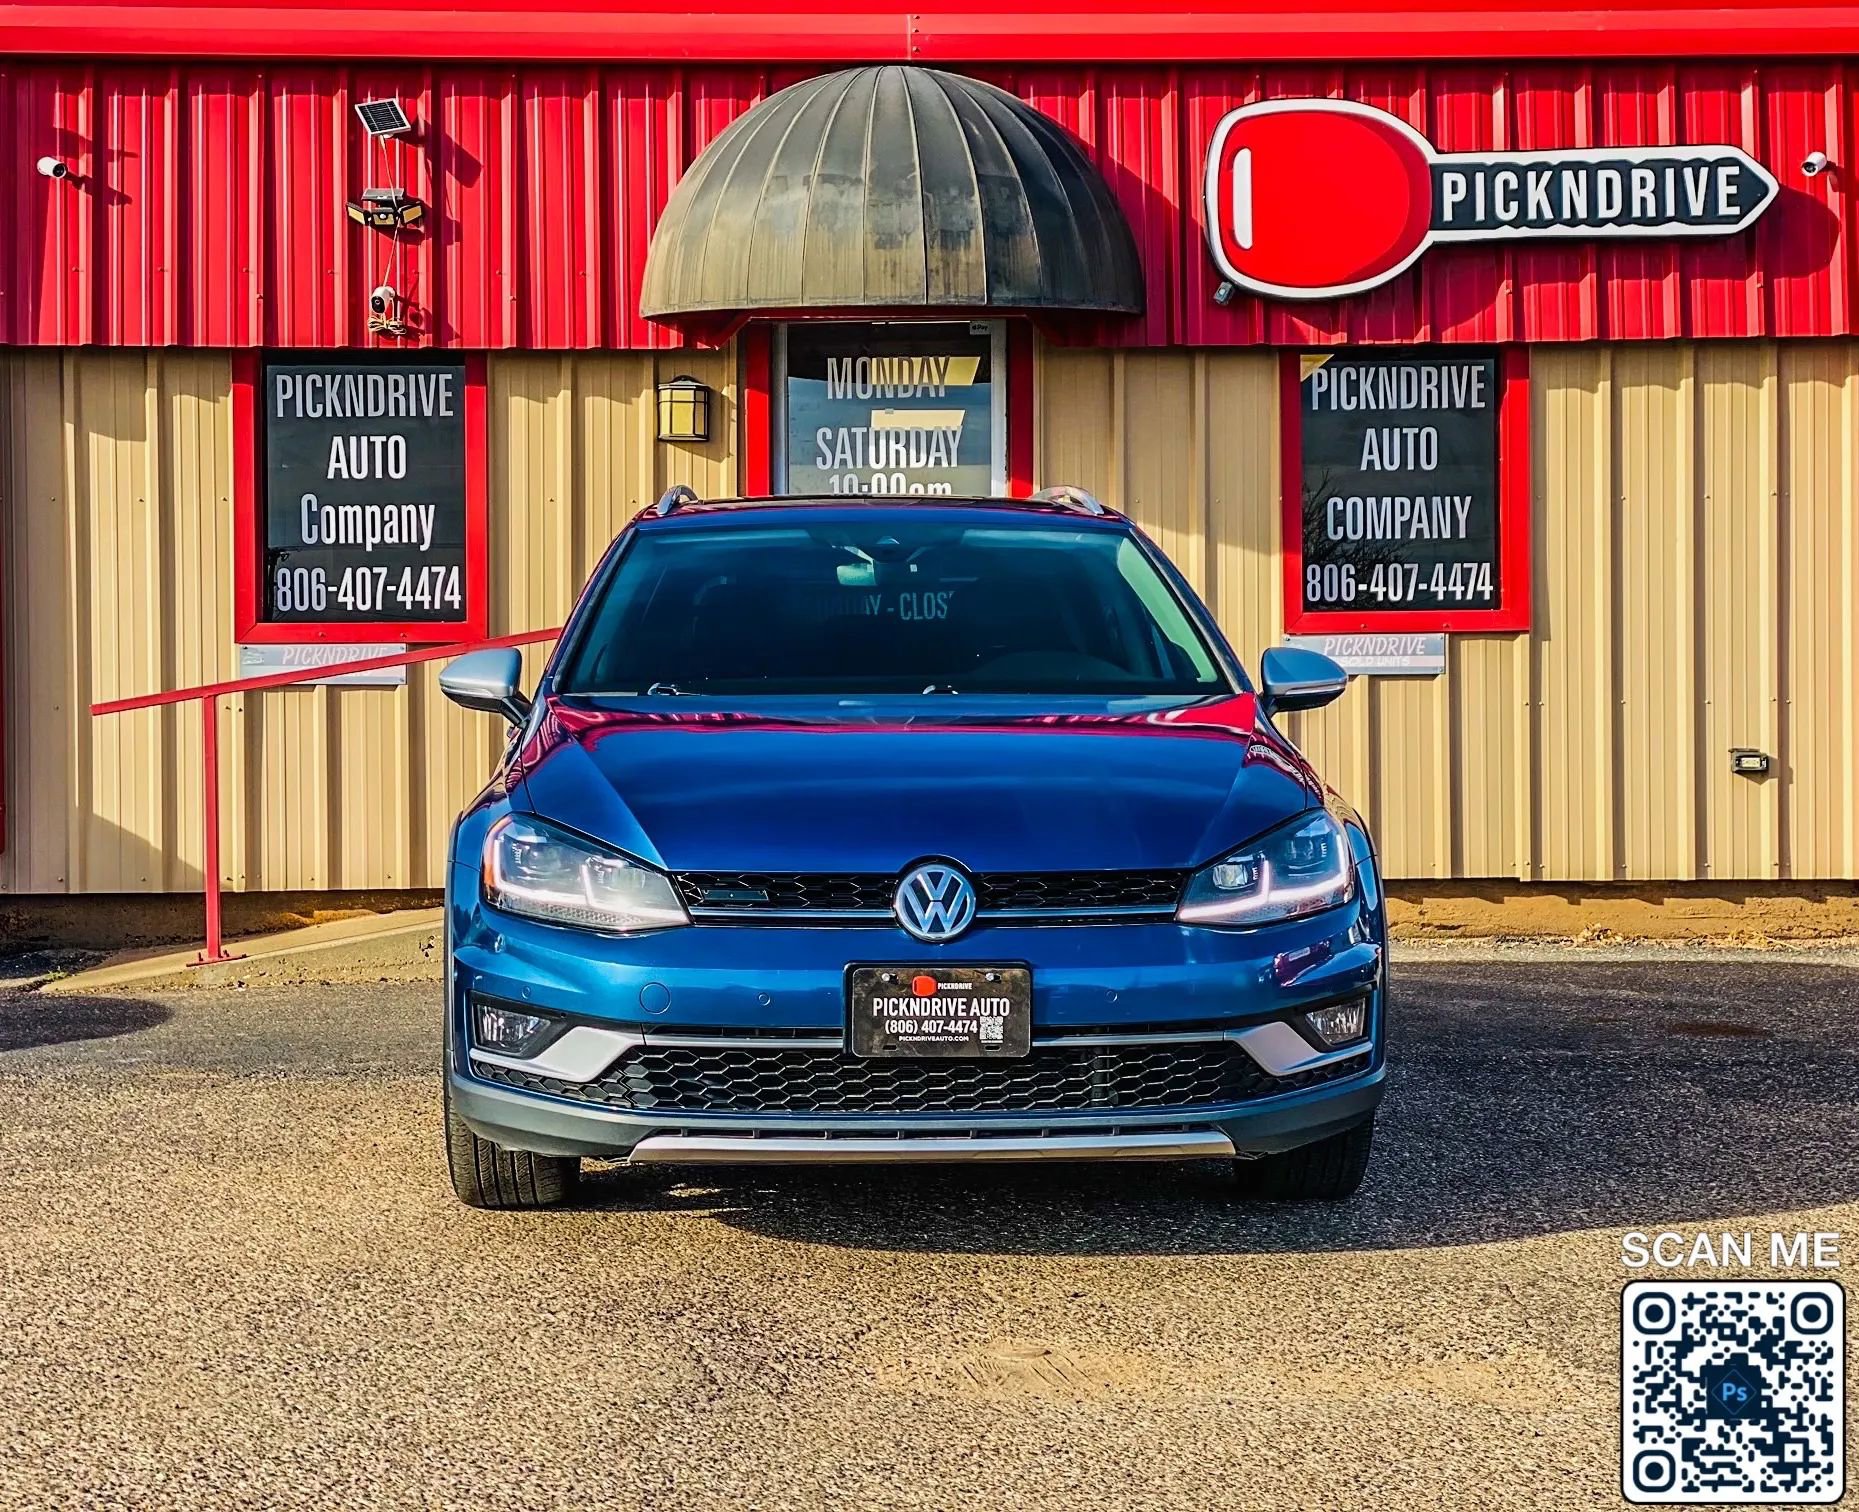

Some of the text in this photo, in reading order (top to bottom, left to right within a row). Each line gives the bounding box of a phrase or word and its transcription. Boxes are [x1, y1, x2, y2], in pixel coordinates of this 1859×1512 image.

[1443, 165, 1741, 222] PICKNDRIVE
[276, 373, 454, 418] PICKNDRIVE
[827, 355, 951, 400] MONDAY
[1312, 365, 1486, 411] PICKNDRIVE
[327, 434, 406, 480] AUTO
[816, 425, 963, 470] SATURDAY
[1360, 426, 1438, 472] AUTO
[301, 493, 436, 552] Company
[1327, 496, 1473, 541] COMPANY
[277, 565, 462, 612] 806-407-4474
[1306, 562, 1494, 603] 806-407-4474
[1323, 636, 1427, 656] PICKNDRIVE
[873, 997, 1010, 1017] PICKNDRIVE AUTO
[937, 982, 973, 990] PICKNDRIVE
[885, 1019, 978, 1035] (806) 407-4474
